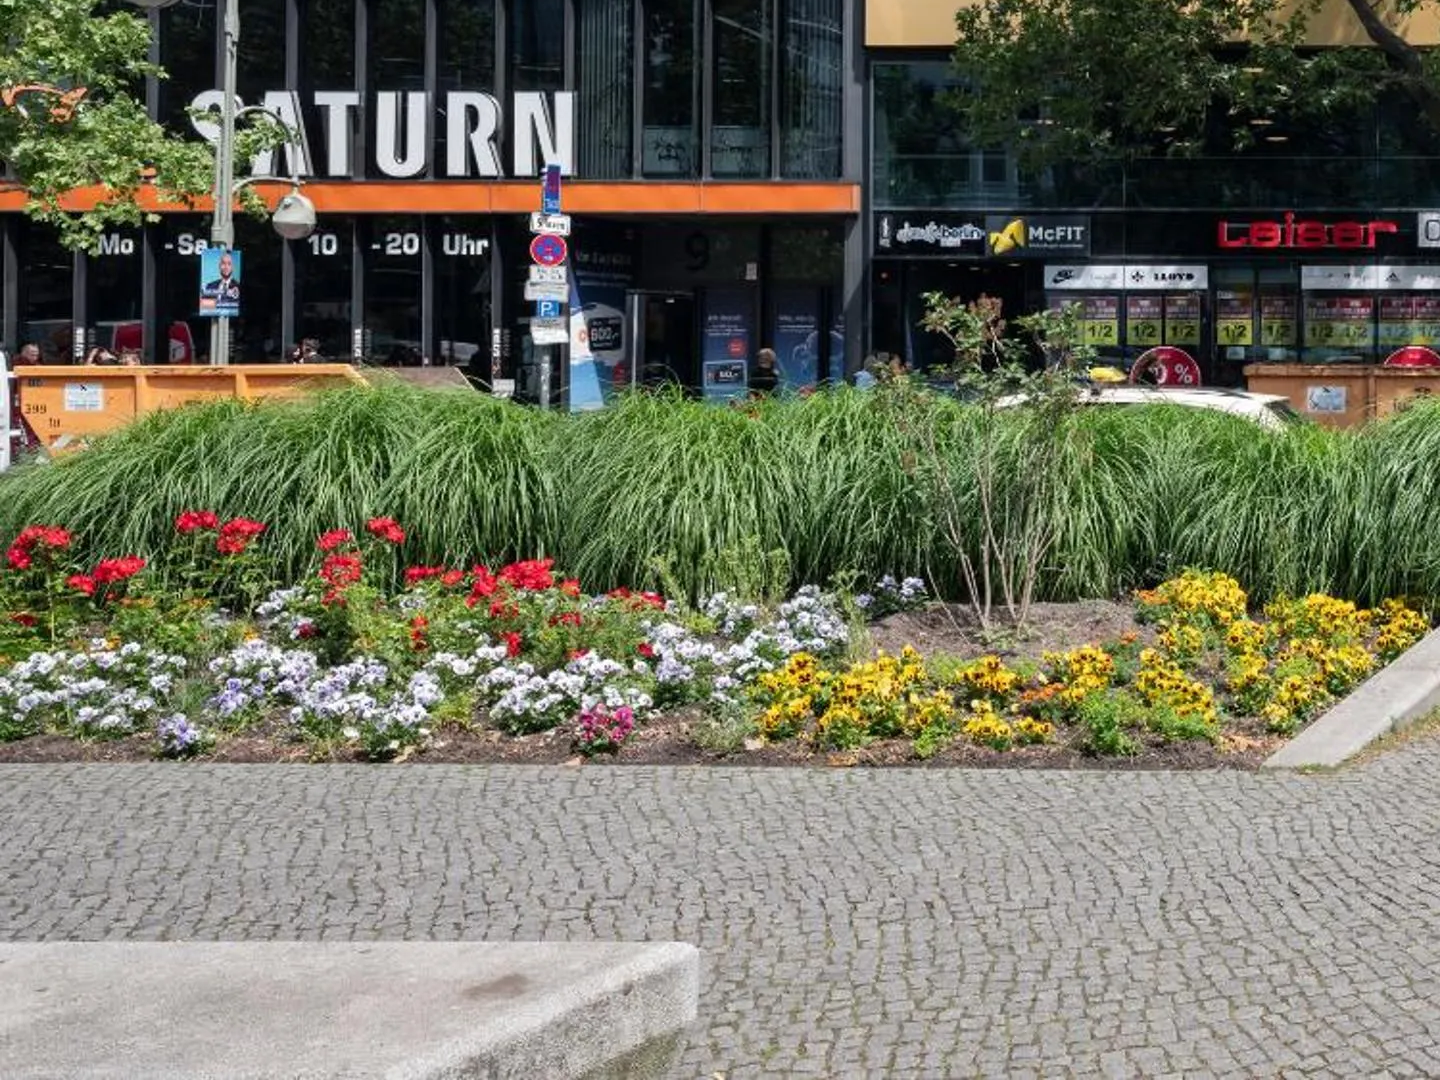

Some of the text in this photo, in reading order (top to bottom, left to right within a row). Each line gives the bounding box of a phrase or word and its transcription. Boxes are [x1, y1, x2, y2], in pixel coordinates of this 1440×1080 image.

[1028, 226, 1085, 241] McFIT
[99, 233, 134, 255] Mo
[308, 234, 338, 255] 10
[385, 233, 420, 255] 20
[443, 233, 489, 255] Uhr
[1089, 324, 1114, 339] 1/2
[1170, 324, 1197, 339] 1/2
[1222, 324, 1247, 339] 1/2
[1309, 324, 1335, 339] 1/2
